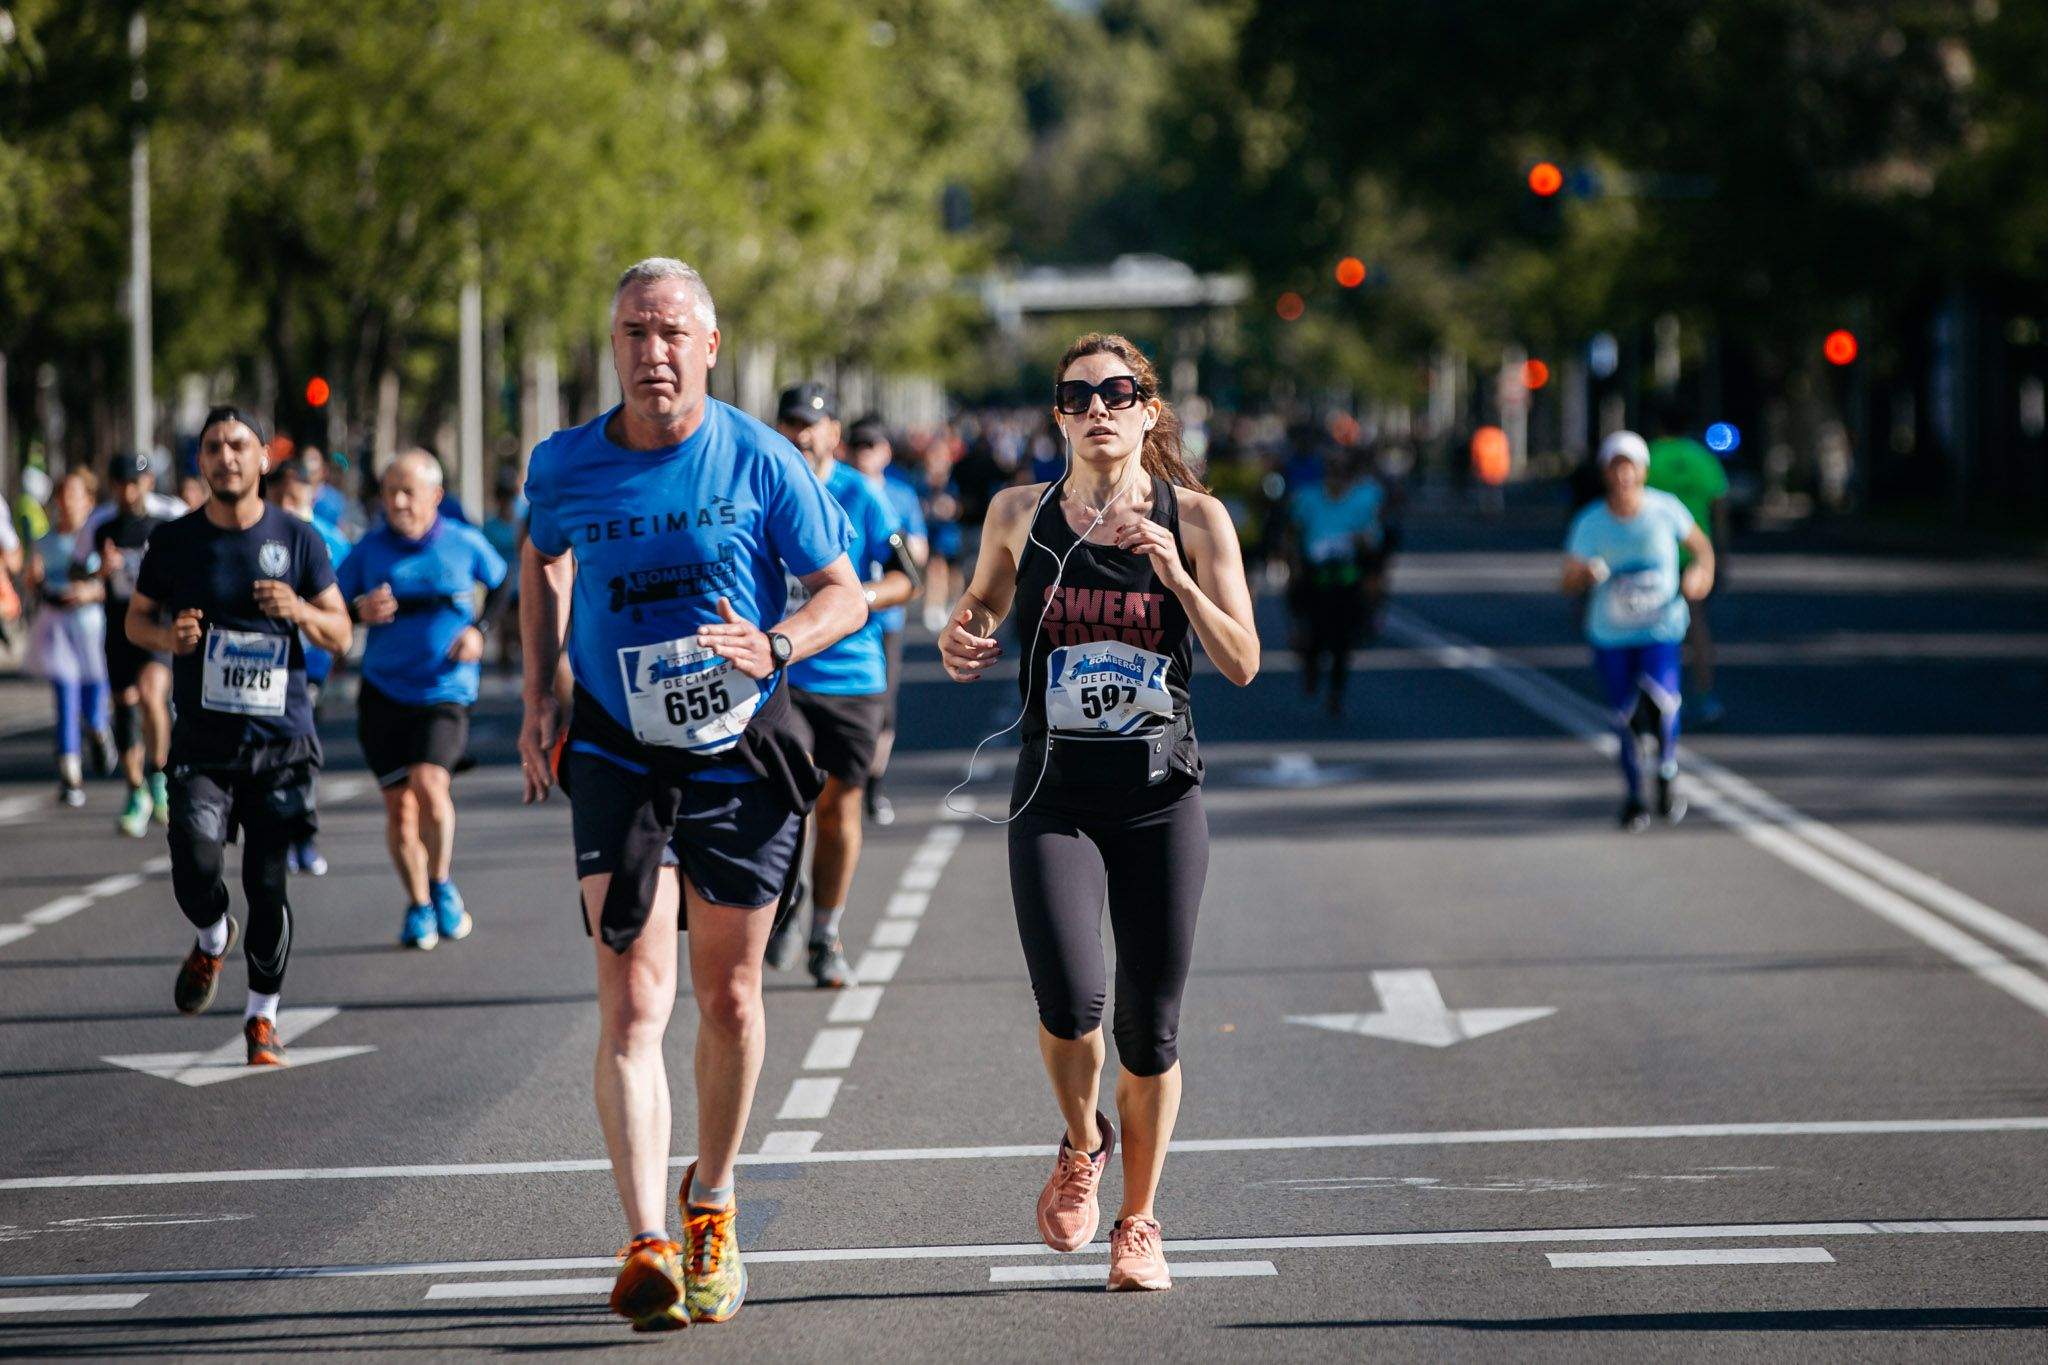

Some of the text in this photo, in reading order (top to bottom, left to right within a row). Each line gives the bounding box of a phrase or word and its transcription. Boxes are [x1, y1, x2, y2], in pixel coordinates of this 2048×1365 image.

[587, 504, 737, 543] DECIMAS
[635, 560, 732, 586] BOMBEROS
[1042, 585, 1165, 630] SWEAT
[664, 665, 728, 689] DECIMAS
[1089, 654, 1142, 673] BOMBEROS
[1081, 673, 1142, 686] DECIMAS
[664, 680, 730, 726] 655
[1081, 684, 1138, 719] 597
